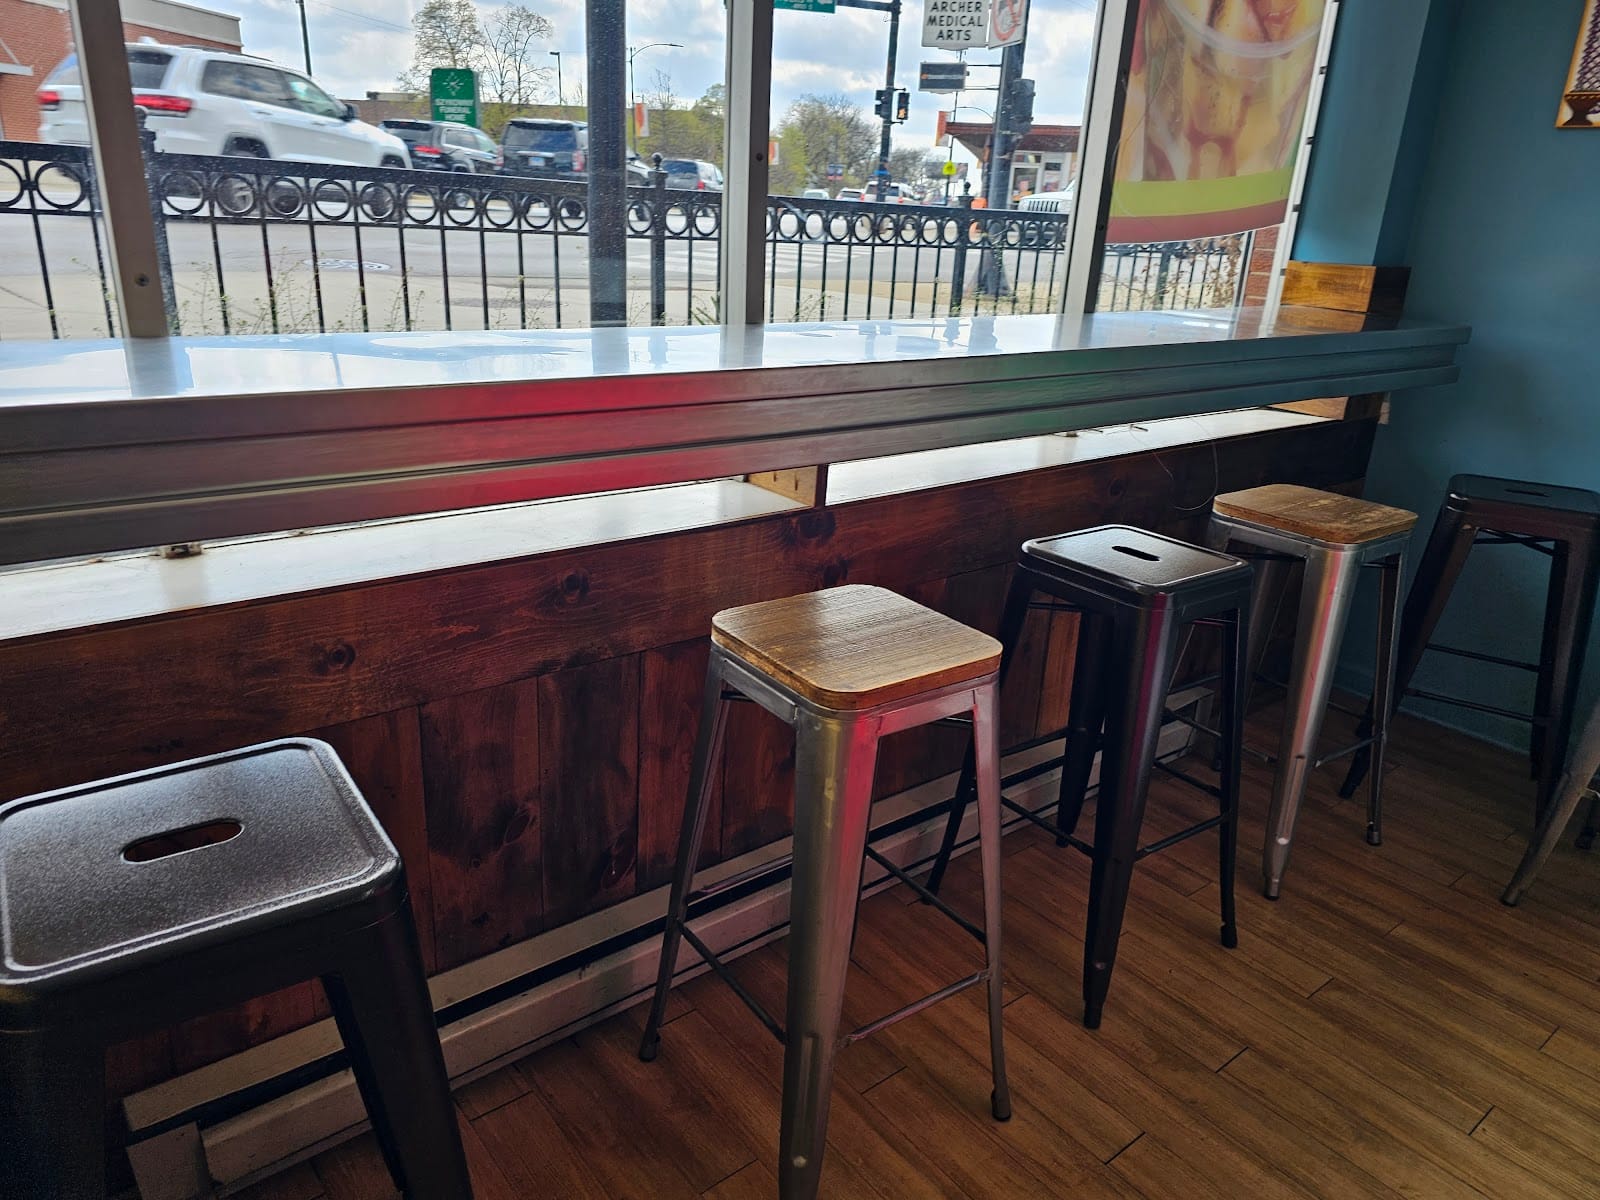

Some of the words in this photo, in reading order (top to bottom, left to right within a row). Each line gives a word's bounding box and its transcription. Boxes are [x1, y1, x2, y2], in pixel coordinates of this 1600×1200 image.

[930, 1, 982, 12] ARCHER
[926, 15, 984, 27] MEDICAL
[936, 29, 972, 41] ARTS
